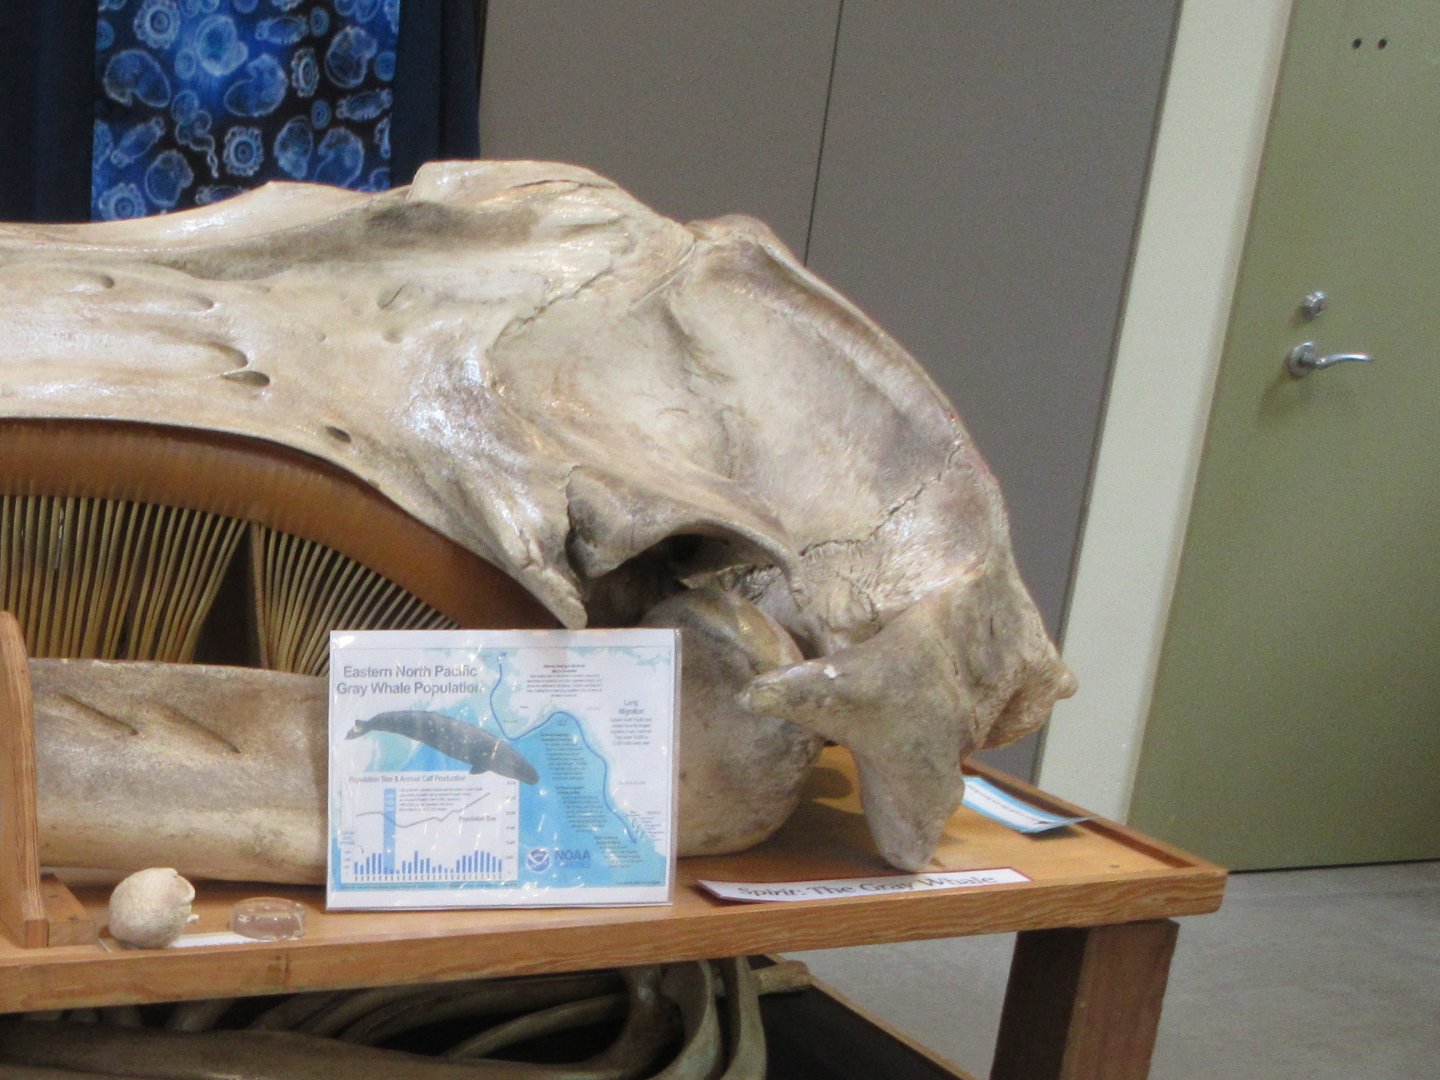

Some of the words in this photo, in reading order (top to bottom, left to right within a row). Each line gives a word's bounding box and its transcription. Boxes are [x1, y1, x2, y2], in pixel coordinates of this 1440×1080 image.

[344, 666, 392, 677] Eastern
[396, 666, 431, 677] North
[435, 665, 477, 677] Pacific
[337, 682, 367, 696] Gray
[371, 682, 410, 693] Whale
[556, 850, 590, 860] NOAA
[738, 887, 806, 897] Spirit:
[806, 885, 856, 895] The
[859, 882, 914, 891] Gray
[917, 876, 996, 885] Whale
